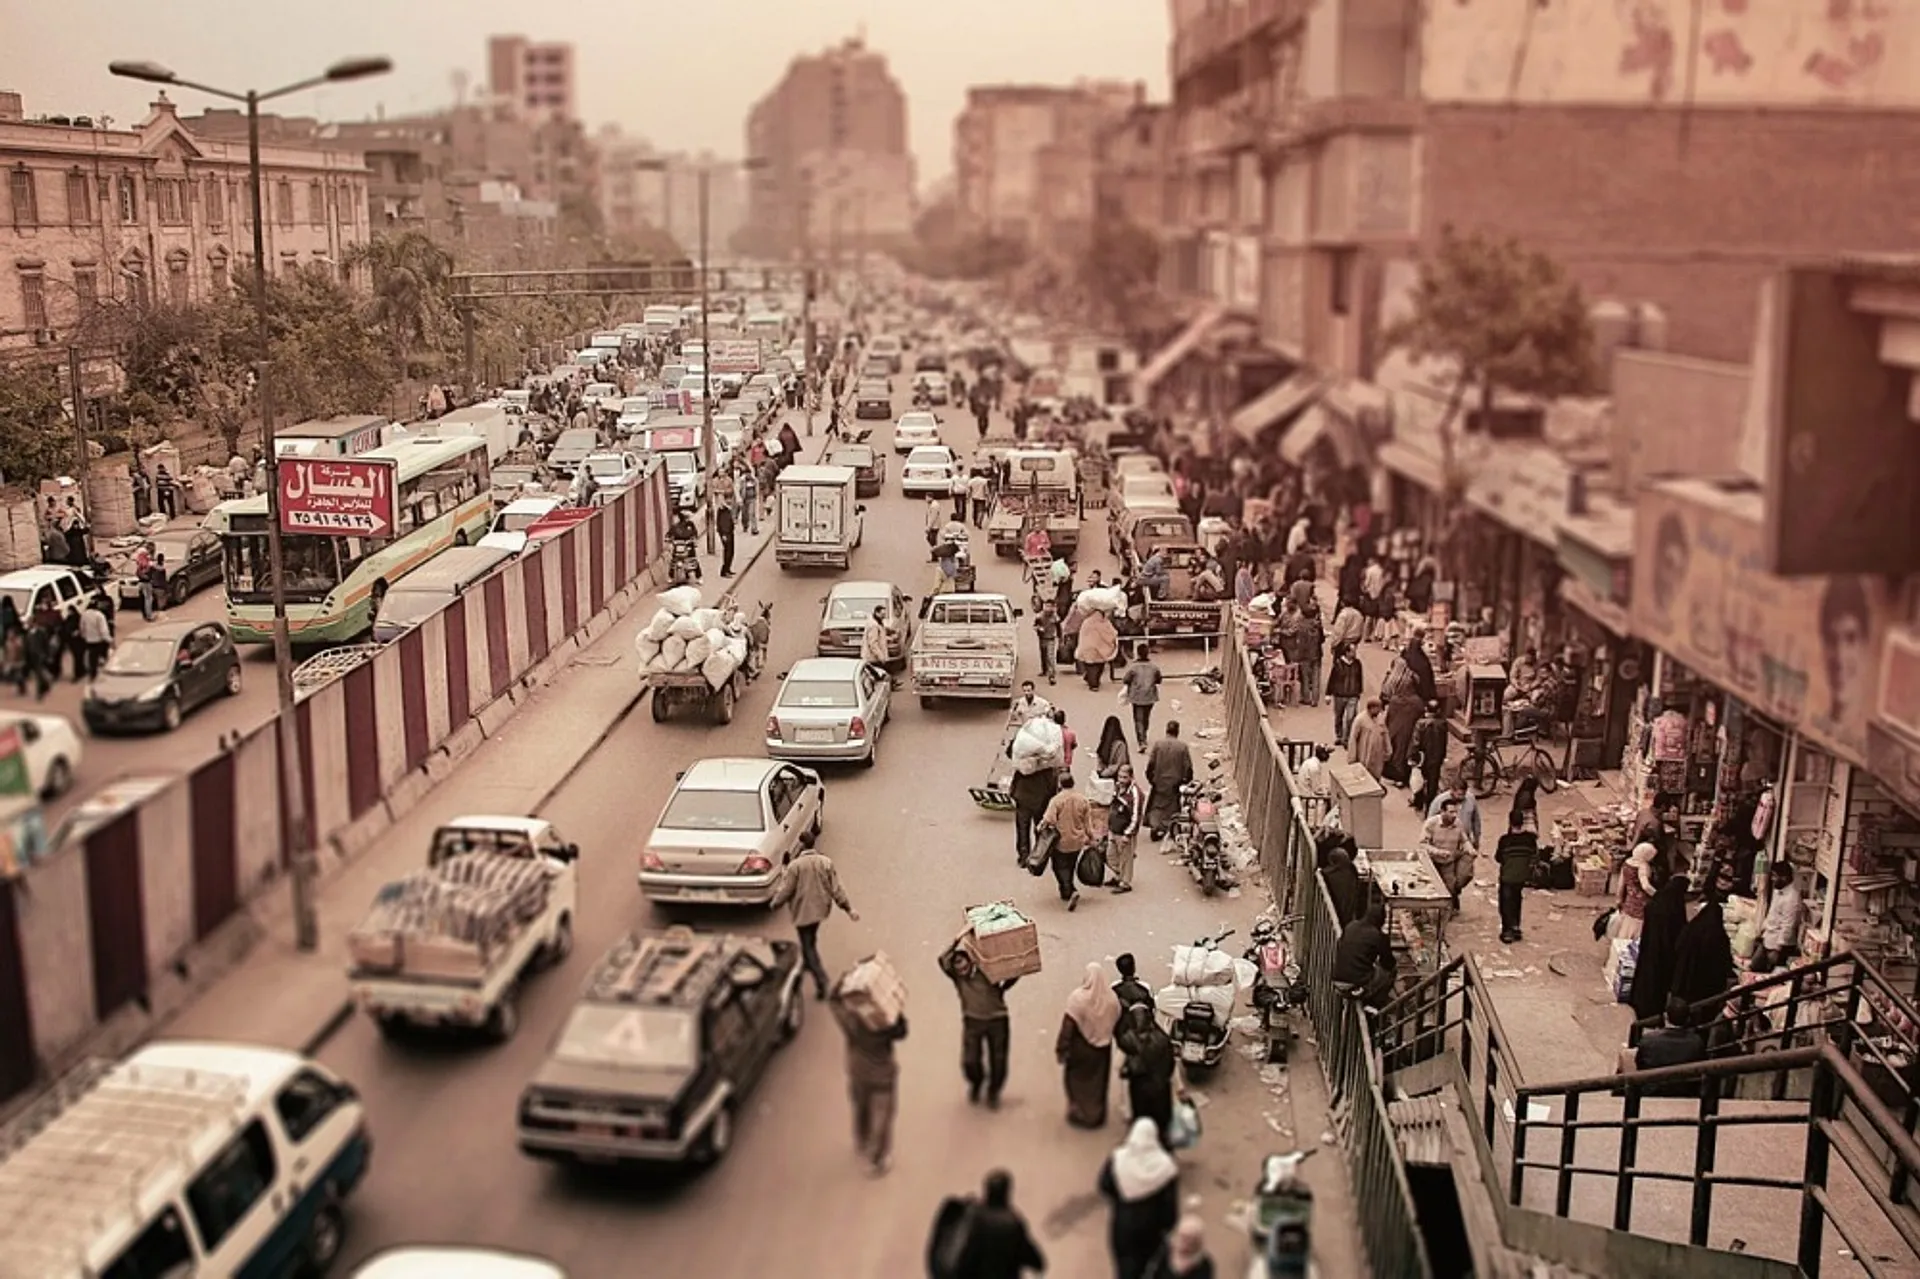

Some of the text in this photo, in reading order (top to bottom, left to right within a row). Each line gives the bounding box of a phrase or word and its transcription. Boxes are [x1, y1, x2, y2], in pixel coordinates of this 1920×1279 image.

[320, 464, 351, 476] شركة
[286, 463, 385, 498] العسال
[1161, 611, 1209, 620] SUZUKI
[930, 658, 995, 670] NISSAN
